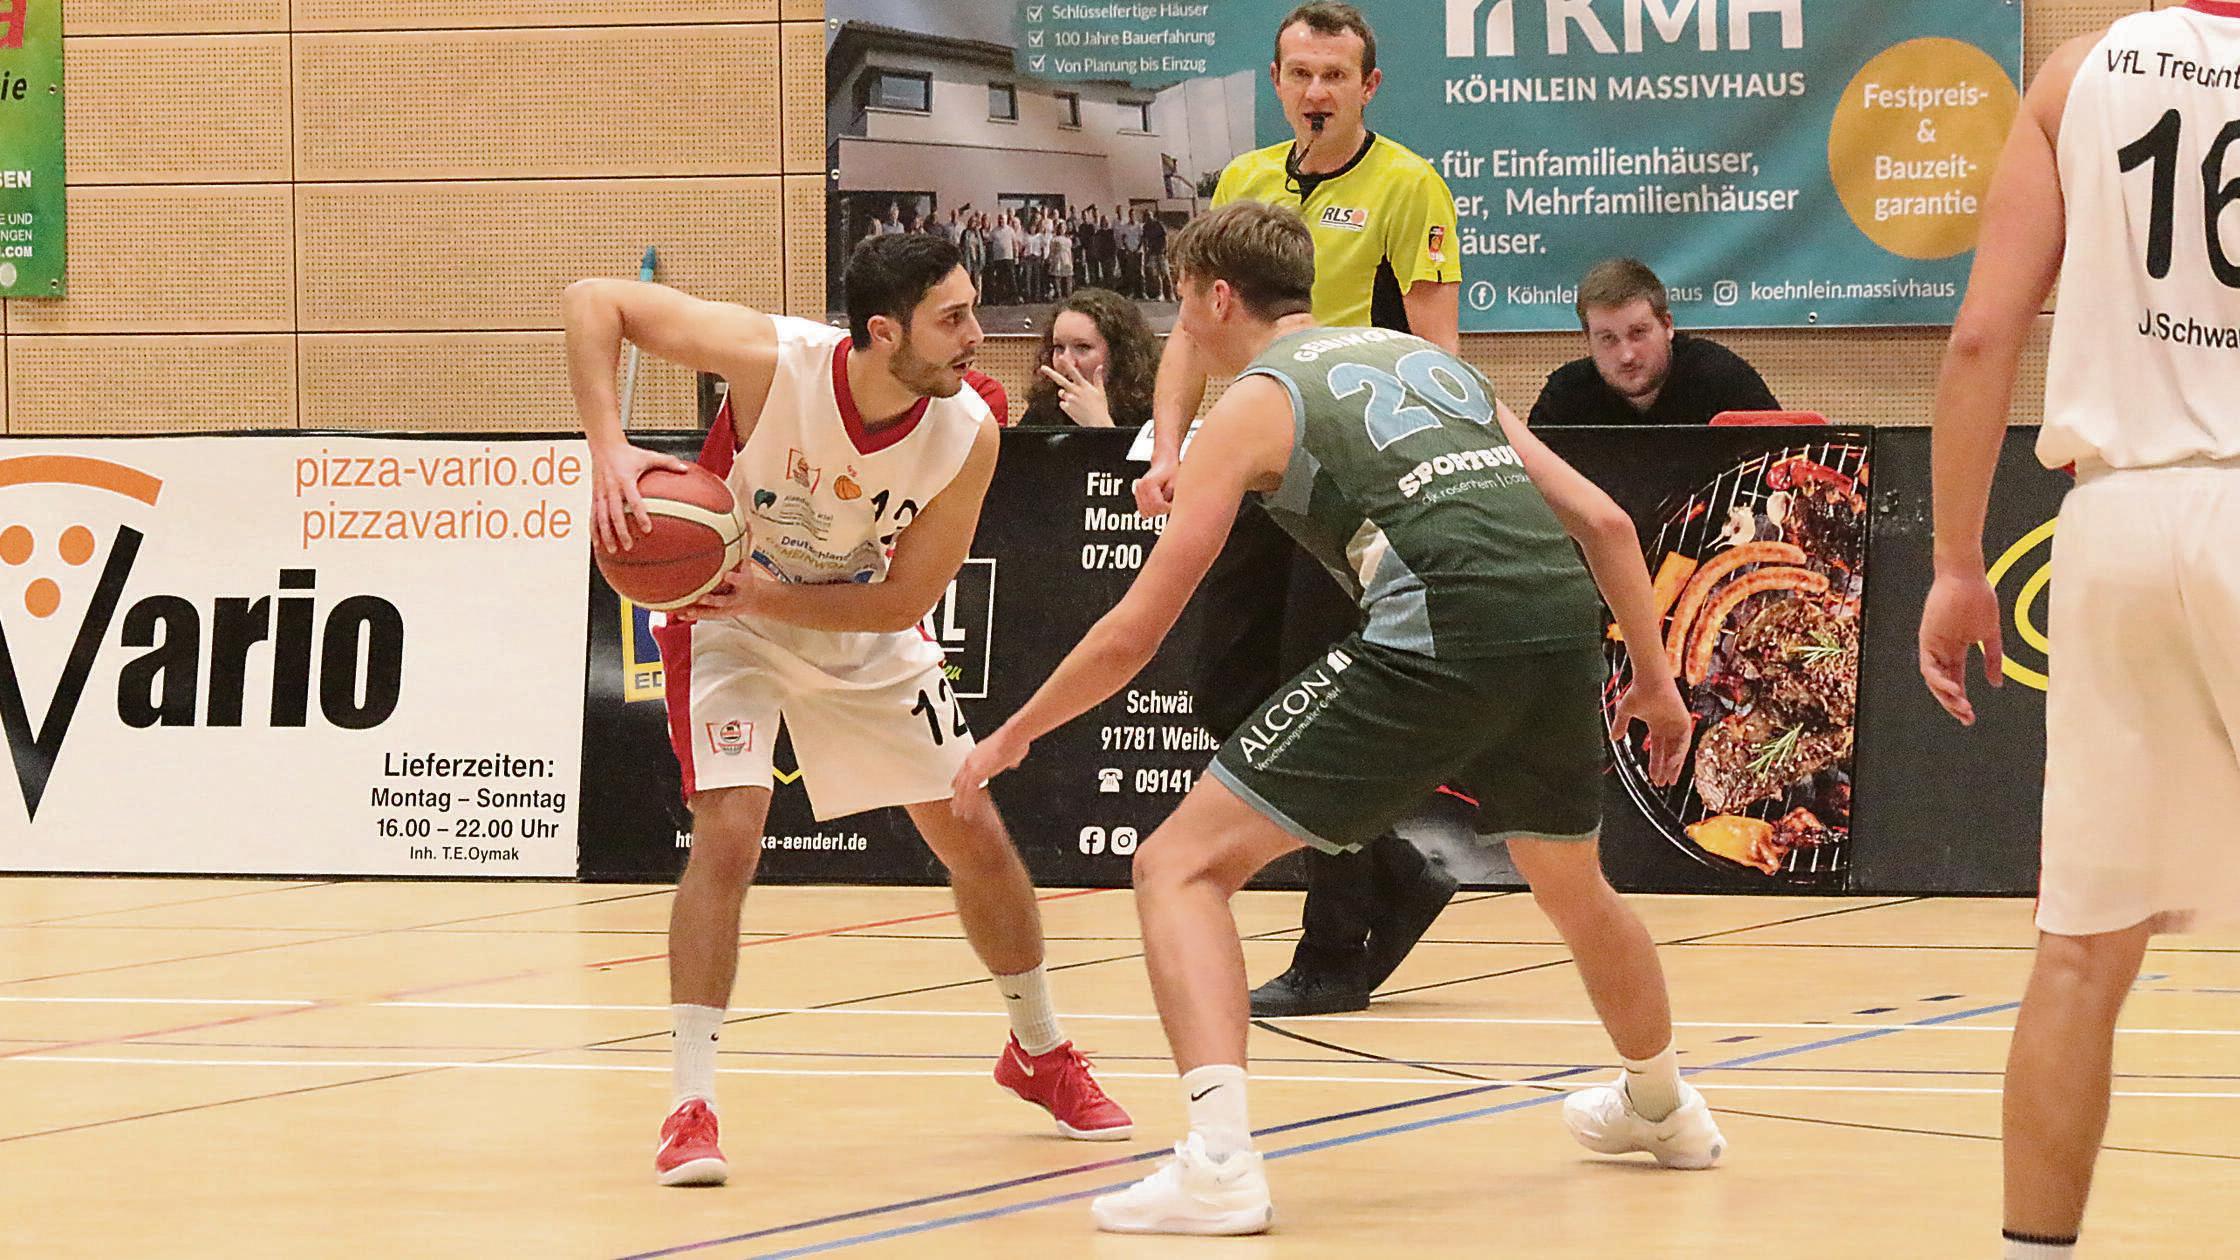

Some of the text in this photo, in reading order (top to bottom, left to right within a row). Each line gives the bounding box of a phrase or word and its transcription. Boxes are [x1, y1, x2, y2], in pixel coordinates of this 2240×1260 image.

[1052, 3, 1209, 20] Schlüsselfertige Häuser
[1054, 30, 1216, 46] 100 Jahre Bauerfahrung
[1054, 57, 1207, 74] Von Planung bis Einzug
[2107, 49, 2146, 75] VfL
[1446, 72, 1806, 104] KÖHNLEIN MASSIVHAUS
[1864, 83, 1988, 109] Festpreis-
[1916, 118, 1937, 142] &
[1442, 147, 1759, 178] für Einfamilienhäuser,
[1875, 155, 1977, 180] Bauzeit-
[1506, 186, 1799, 216] Mehrfamilienhäuser
[1874, 190, 1977, 221] garantie
[2117, 108, 2240, 289] 16
[8, 213, 33, 225] UND
[1322, 207, 1353, 223] RLS
[1751, 279, 1955, 301] koehnlein.massivhaus
[1327, 350, 1494, 451] 20
[296, 448, 582, 497] pizza-vario.de
[1086, 472, 1123, 496] Für
[303, 500, 572, 549] pizzavario.de
[1081, 544, 1142, 570] 07:00
[1240, 669, 1331, 763] ALCON
[1101, 726, 1155, 750] 91781
[384, 753, 554, 778] Lieferzeiten:
[371, 787, 451, 812] Montag
[476, 787, 566, 812] Sonntag
[377, 818, 430, 838] 16.00
[455, 818, 513, 838] 22.00
[521, 818, 559, 838] Uhr
[410, 846, 519, 863] Inh. T.E.Oymak
